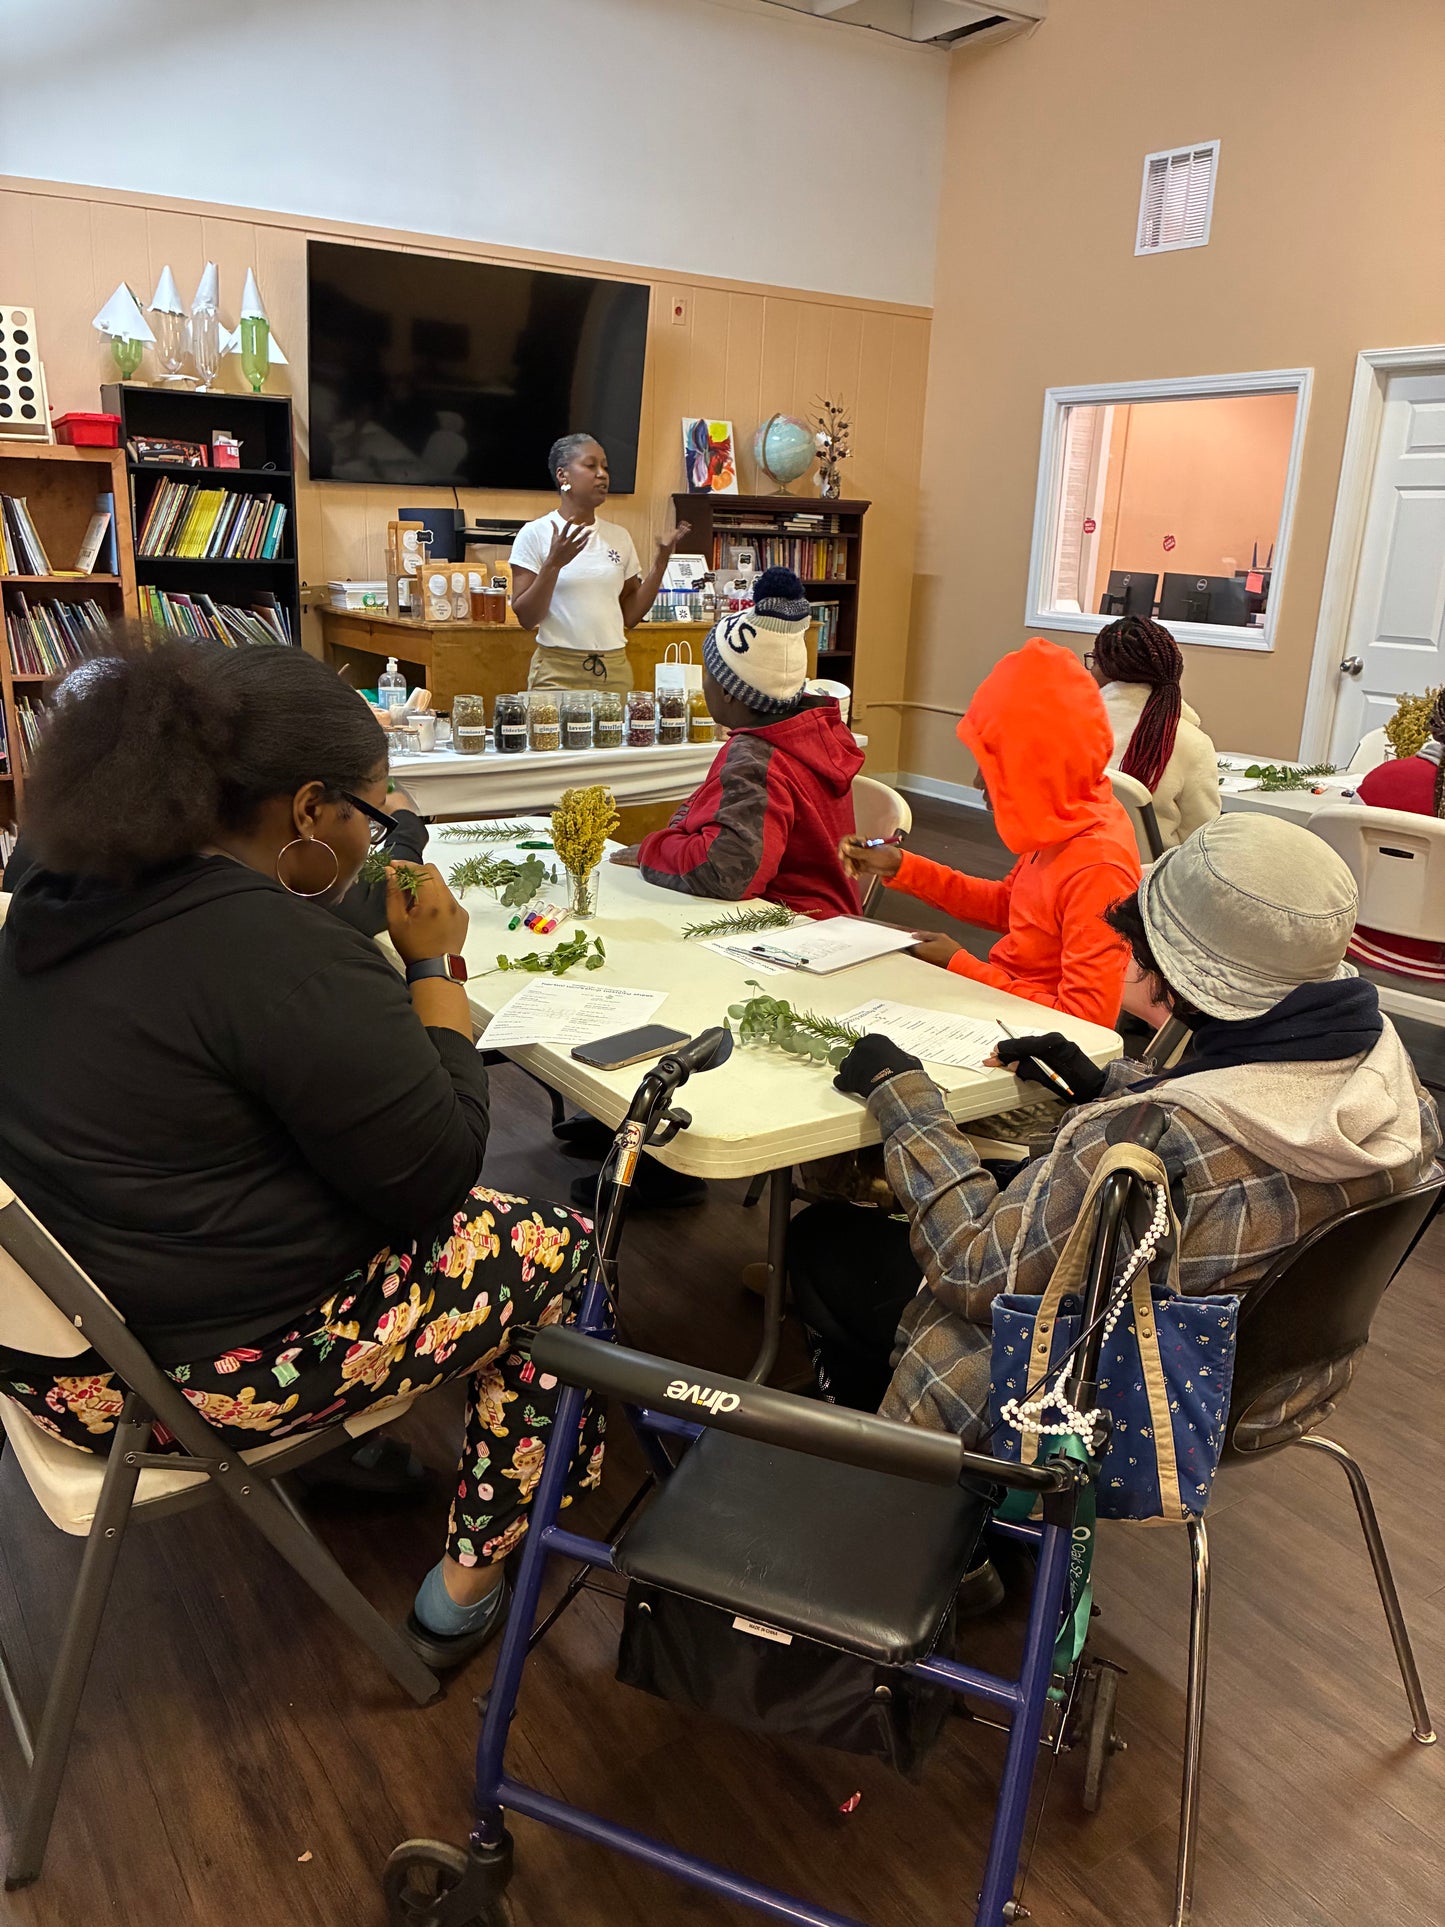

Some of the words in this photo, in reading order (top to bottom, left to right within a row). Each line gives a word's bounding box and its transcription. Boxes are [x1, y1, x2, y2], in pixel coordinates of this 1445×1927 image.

[665, 1380, 740, 1415] drive
[1071, 1543, 1086, 1563] Oak
[749, 1623, 760, 1631] MADE
[766, 1628, 778, 1636] CHINA
